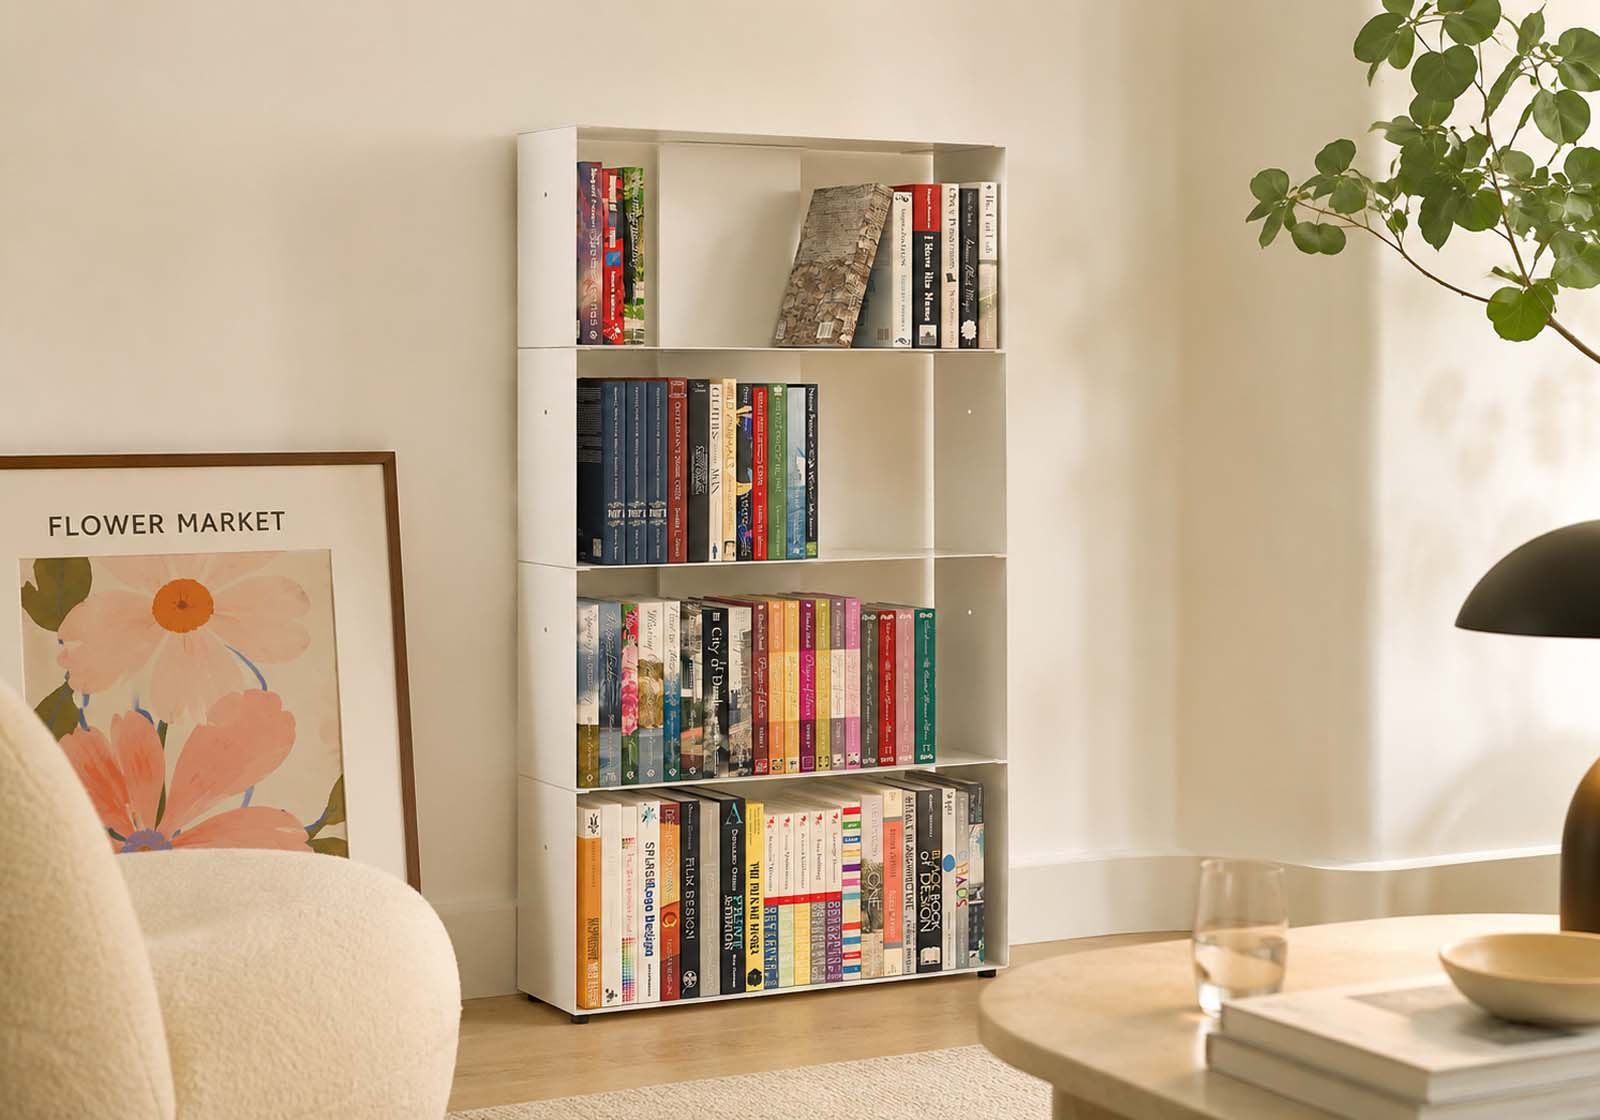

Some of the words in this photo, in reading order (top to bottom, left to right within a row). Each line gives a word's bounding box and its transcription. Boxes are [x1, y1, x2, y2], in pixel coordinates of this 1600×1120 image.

[48, 514, 165, 536] FLOWER
[177, 511, 286, 533] MARKET
[707, 627, 722, 655] City
